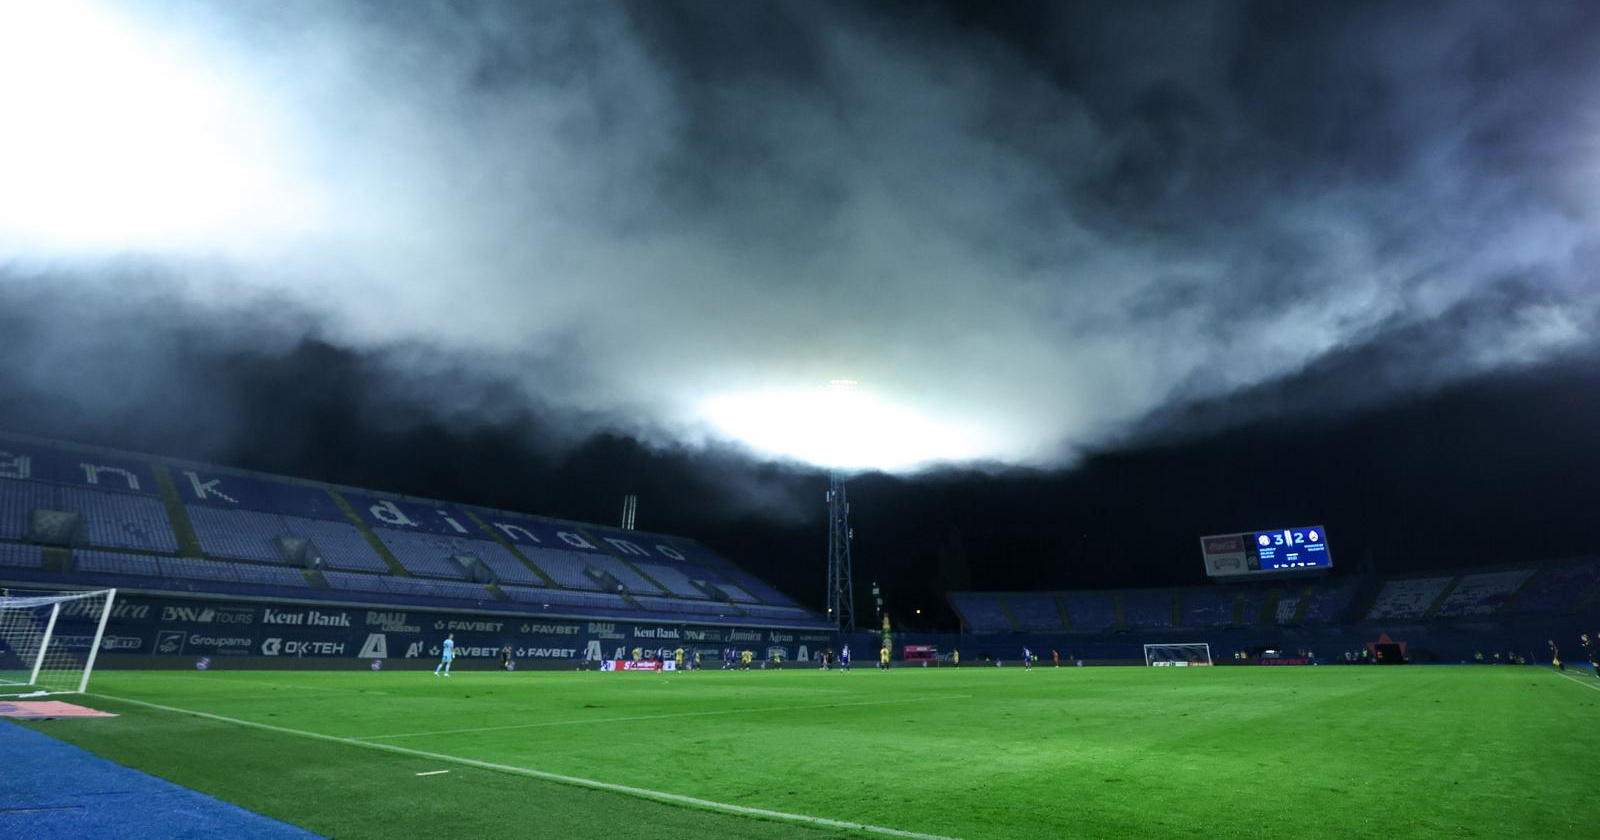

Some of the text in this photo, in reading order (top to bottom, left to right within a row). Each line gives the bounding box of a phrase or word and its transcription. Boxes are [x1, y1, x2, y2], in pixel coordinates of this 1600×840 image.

[367, 499, 687, 562] dinamo
[1273, 532, 1305, 546] 3 2
[216, 612, 253, 625] TOURS
[263, 608, 352, 627] Kent Bank
[447, 620, 504, 632] FAVBET
[531, 624, 580, 635] FAVBET
[633, 626, 656, 638] Kent
[656, 627, 680, 639] Bank
[189, 634, 252, 647] Groupama
[453, 646, 500, 657] AVBET
[527, 647, 577, 658] FAVBET
